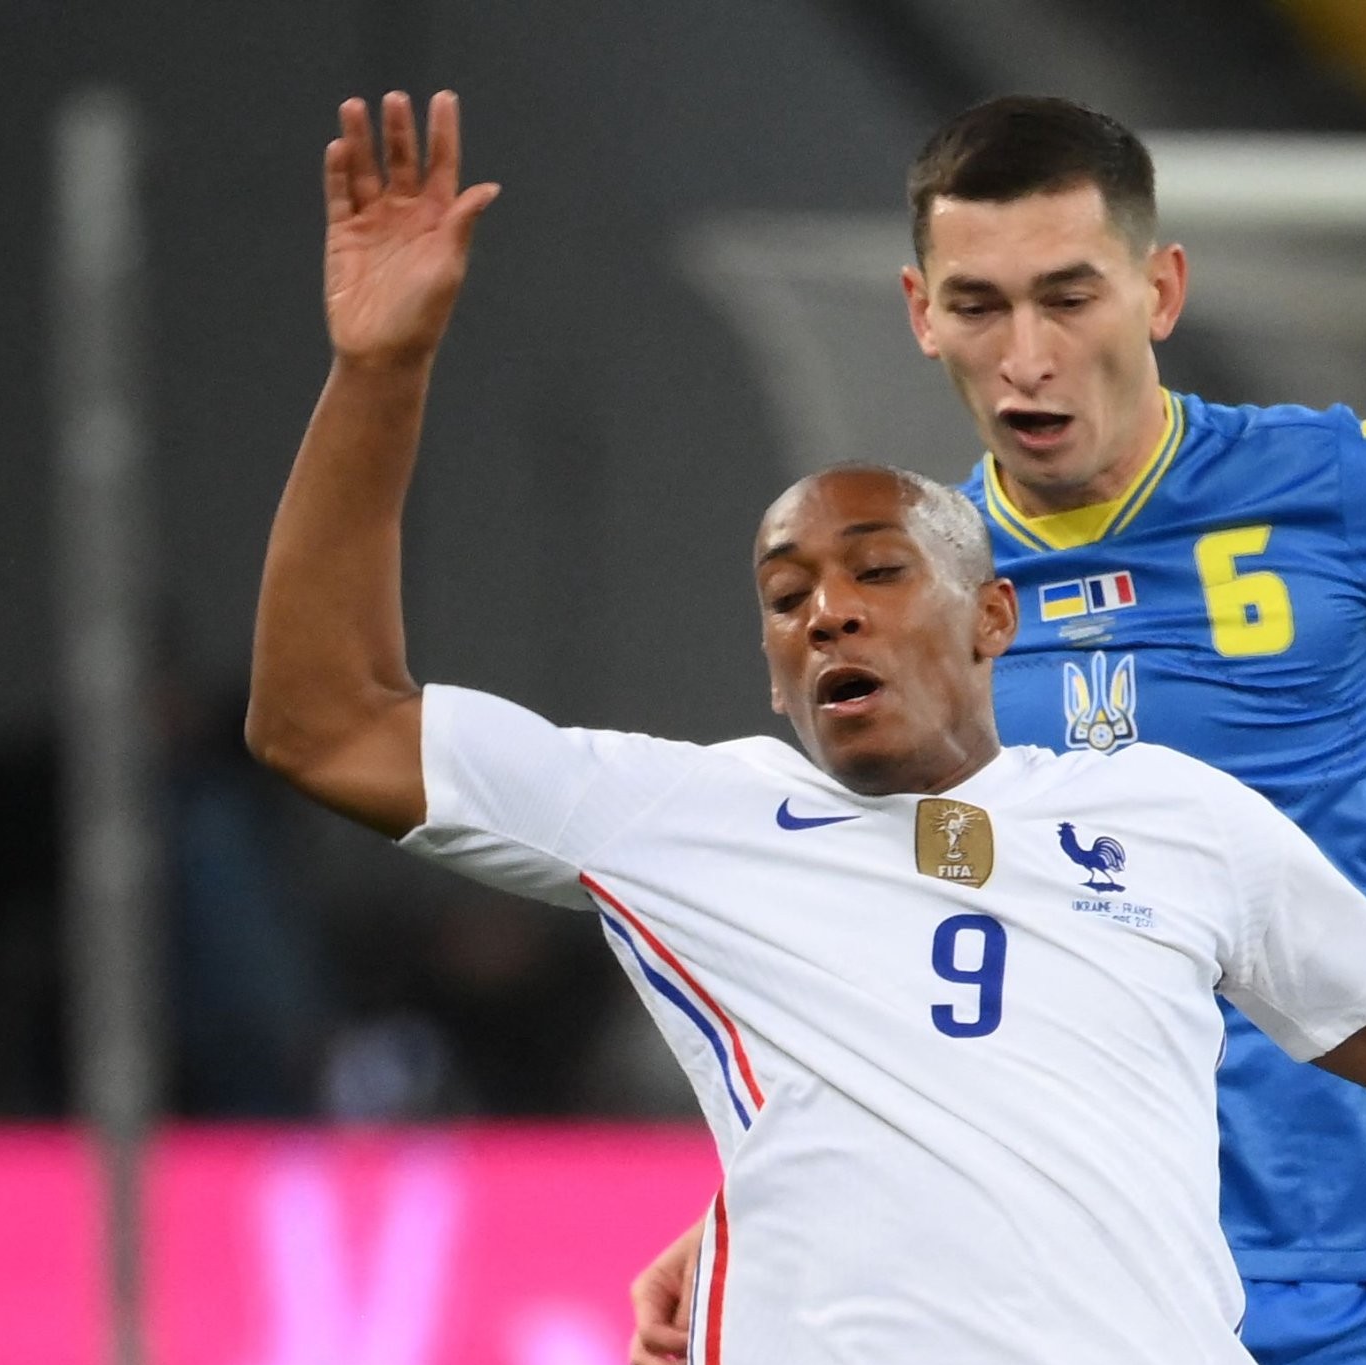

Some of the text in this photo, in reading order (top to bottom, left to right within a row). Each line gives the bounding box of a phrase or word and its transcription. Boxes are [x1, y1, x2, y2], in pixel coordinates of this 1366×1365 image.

[1193, 524, 1296, 658] 6
[938, 864, 972, 878] FIFA
[930, 913, 1008, 1039] 9
